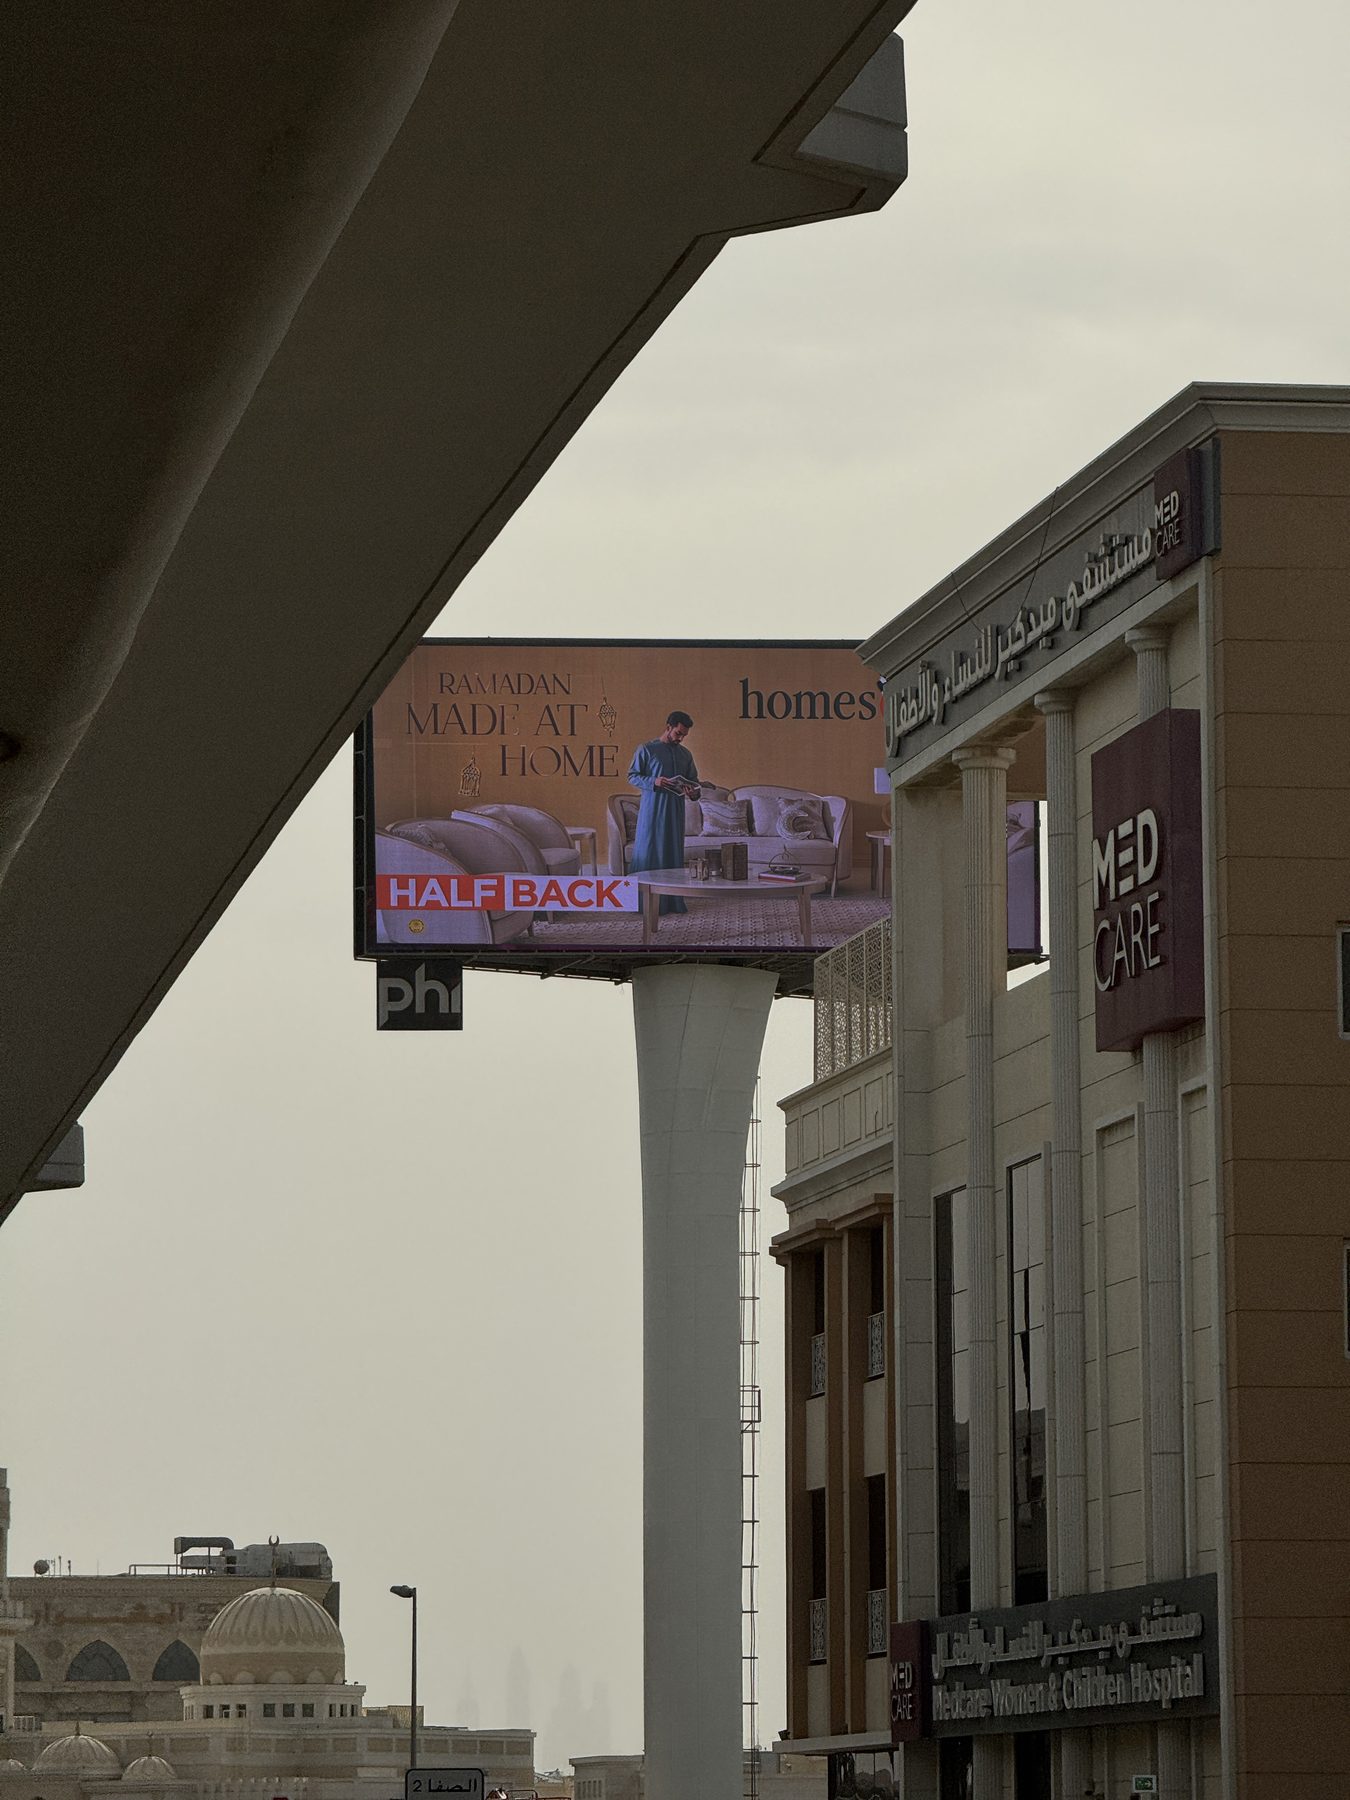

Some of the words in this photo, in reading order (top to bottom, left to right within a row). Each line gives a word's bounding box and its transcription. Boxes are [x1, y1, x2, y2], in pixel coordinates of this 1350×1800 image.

[1155, 490, 1180, 526] MED
[1156, 517, 1181, 556] CARE
[1062, 528, 1153, 631] مستشفى
[438, 672, 571, 695] RAMADAN
[739, 677, 877, 720] homes
[405, 703, 519, 736] MADE
[534, 703, 588, 736] AT
[500, 744, 618, 777] HOME
[1092, 808, 1159, 911] MED
[389, 878, 498, 907] HALF
[1094, 891, 1161, 992] CARE
[1115, 1598, 1204, 1657] مستشفى
[891, 1661, 913, 1690] MED
[932, 1681, 992, 1721] Medcare
[991, 1678, 1049, 1716] Women
[1048, 1672, 1063, 1711] &
[1062, 1665, 1130, 1709] Children
[1130, 1653, 1204, 1709] Hospital
[891, 1693, 913, 1722] CARE
[412, 1779, 422, 1793] 2
[428, 1778, 477, 1793] الصفا
